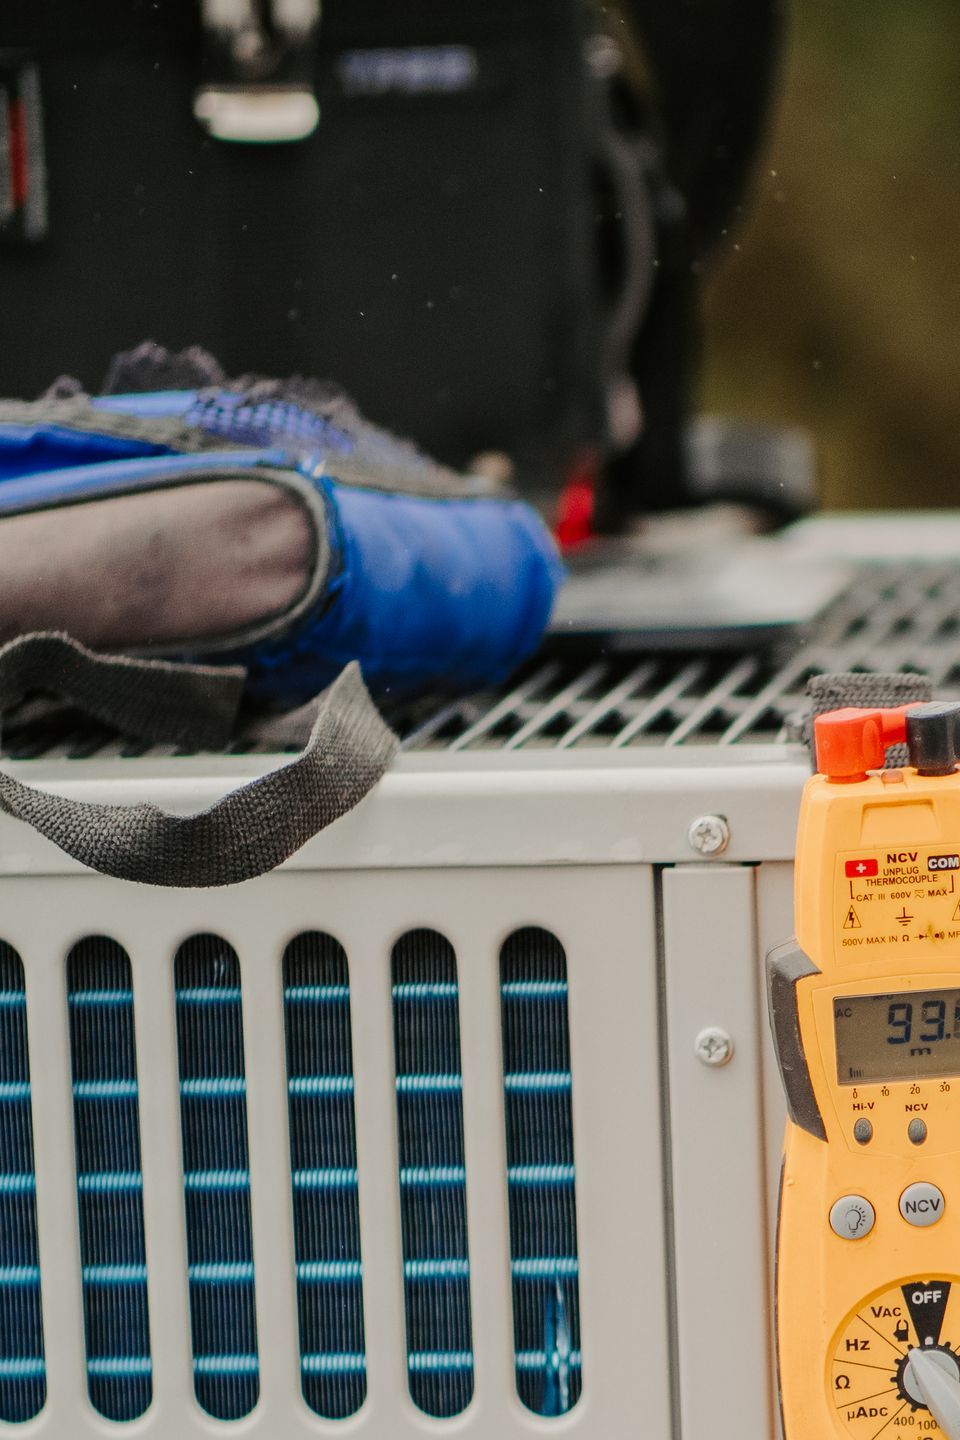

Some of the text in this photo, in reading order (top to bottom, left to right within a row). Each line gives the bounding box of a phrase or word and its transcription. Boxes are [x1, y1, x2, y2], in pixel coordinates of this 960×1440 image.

[887, 852, 918, 863] NCV
[928, 856, 959, 869] COM
[883, 867, 919, 876] UNPLUG
[866, 874, 938, 887] THERMOCOUPLE
[891, 891, 912, 899] 600V
[928, 888, 947, 896] MAX
[842, 938, 863, 946] 500V
[911, 1047, 931, 1056] m
[881, 1088, 890, 1096] 10
[910, 1086, 920, 1094] 20
[940, 1084, 950, 1092] 30
[852, 1102, 875, 1111] Hi-V
[905, 1103, 928, 1112] NCV
[905, 1199, 940, 1213] NCV
[912, 1291, 942, 1304] OFF
[871, 1306, 902, 1318] VAC
[846, 1339, 870, 1351] Hz
[894, 1416, 940, 1430] 400 100
